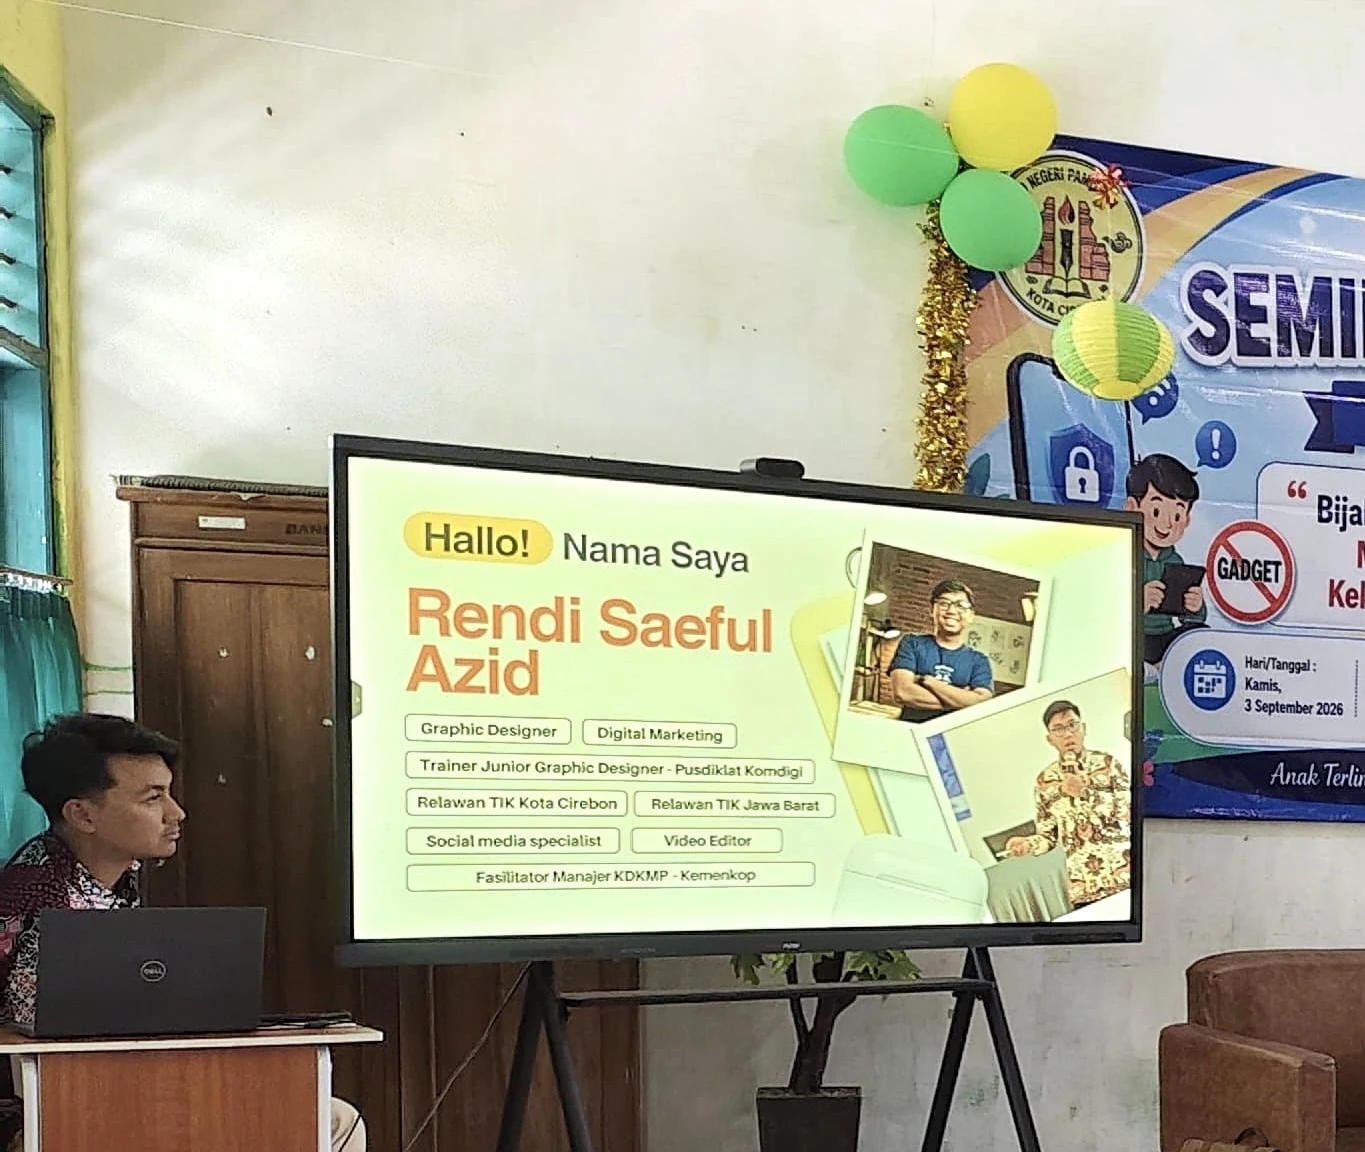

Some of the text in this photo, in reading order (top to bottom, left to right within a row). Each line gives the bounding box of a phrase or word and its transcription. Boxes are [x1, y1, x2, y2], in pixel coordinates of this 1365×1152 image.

[1027, 166, 1065, 189] NEGERI
[1026, 287, 1055, 314] KOTA
[425, 522, 749, 578] Hallo! Nama Saya
[1217, 557, 1282, 583] GADGET
[408, 587, 772, 653] Rendi Saeful
[406, 644, 539, 696] Azid
[1245, 656, 1310, 674] Hari/Tanggal
[1245, 677, 1282, 694] Kamis,
[1244, 699, 1344, 717] 3 September 2026
[421, 722, 557, 739] Graphic Designer
[597, 726, 723, 744] Digital Marketing
[420, 759, 477, 772] Trainer
[481, 760, 531, 773] Junior
[535, 761, 594, 775] Graphic
[598, 762, 664, 777] Designer
[675, 764, 741, 776] Pusdiklat
[745, 765, 803, 779] Komdigi
[1270, 762, 1321, 787] Anak
[417, 796, 618, 810] Relawan TIK Kota Cirebon
[651, 798, 820, 811] Relawan TIK Jawa Barat
[426, 835, 601, 849] Social media specialist
[664, 835, 752, 847] Video Editor
[476, 871, 549, 884] Fasilitator
[553, 870, 611, 885] Manajer
[613, 870, 669, 882] KDKMP
[680, 869, 756, 883] Kemenkop
